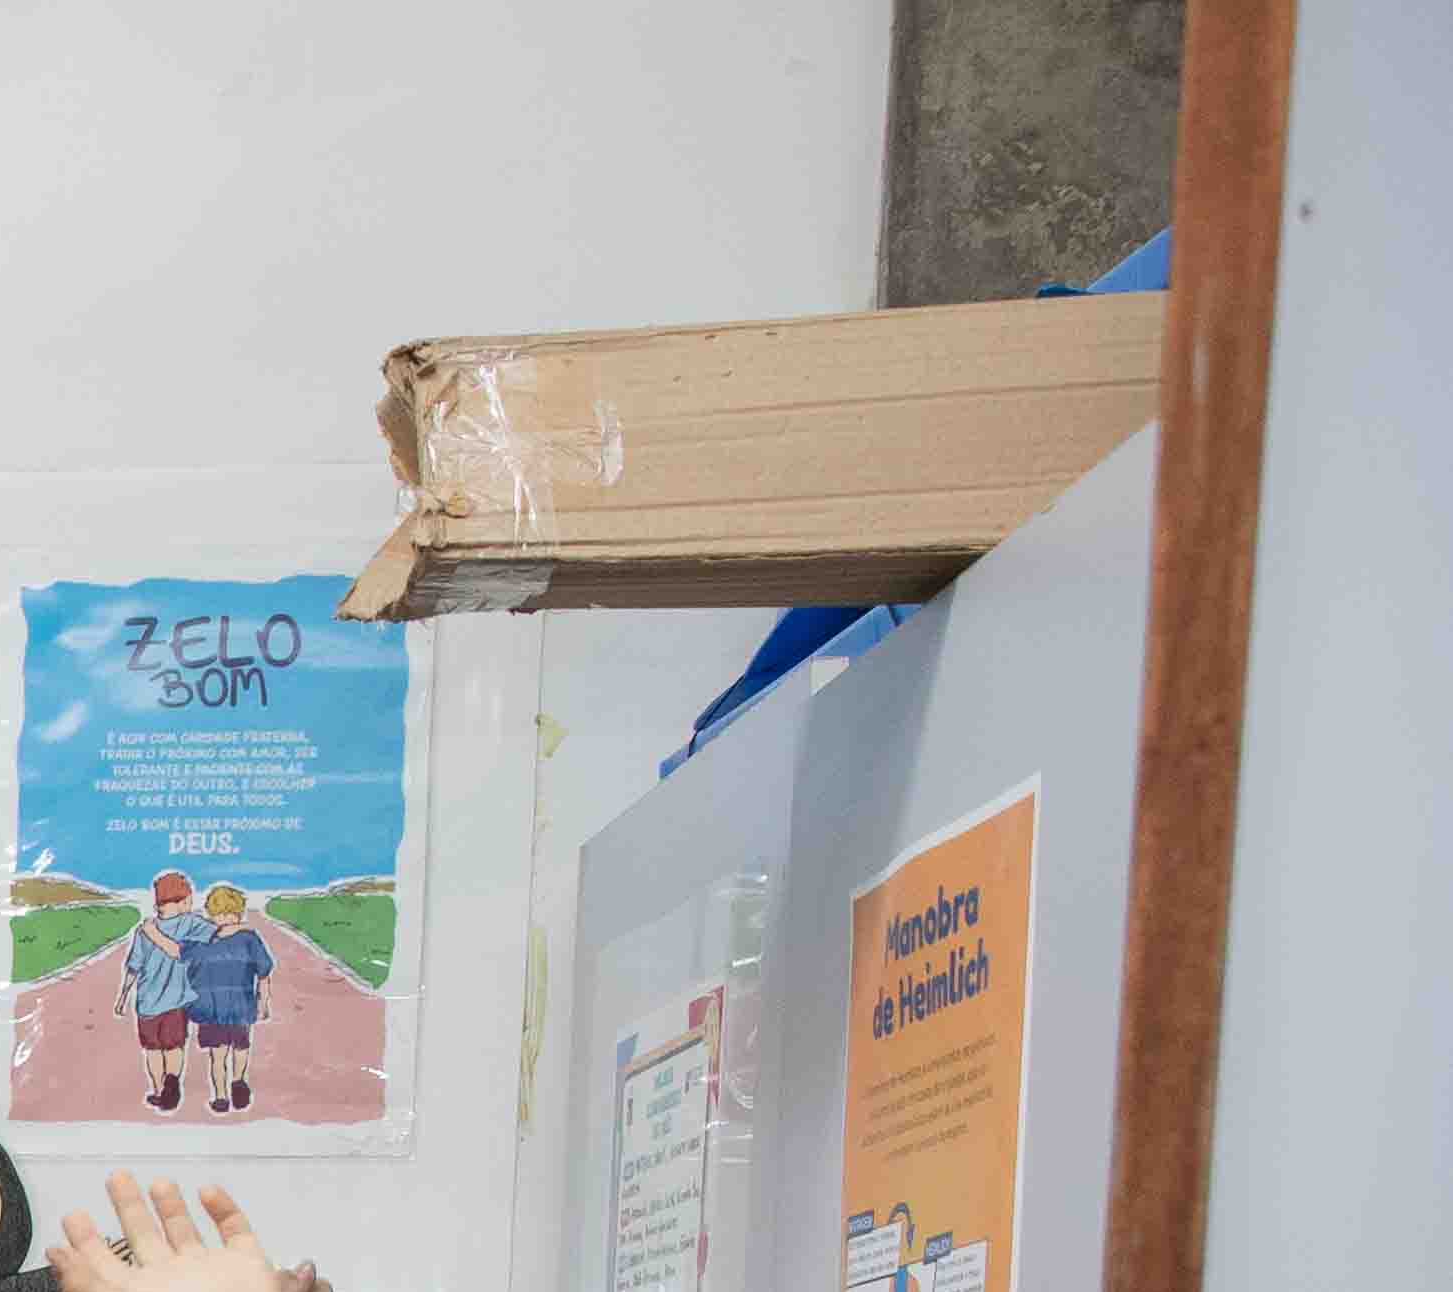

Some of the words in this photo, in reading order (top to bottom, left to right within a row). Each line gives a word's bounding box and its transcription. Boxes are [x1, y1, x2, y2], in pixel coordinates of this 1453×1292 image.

[124, 613, 302, 670] ZELO
[151, 667, 269, 709] BOM
[168, 831, 241, 856] DEUS.
[884, 884, 981, 968] Manobra
[873, 985, 894, 1041] de
[898, 937, 990, 1030] Heimlich
